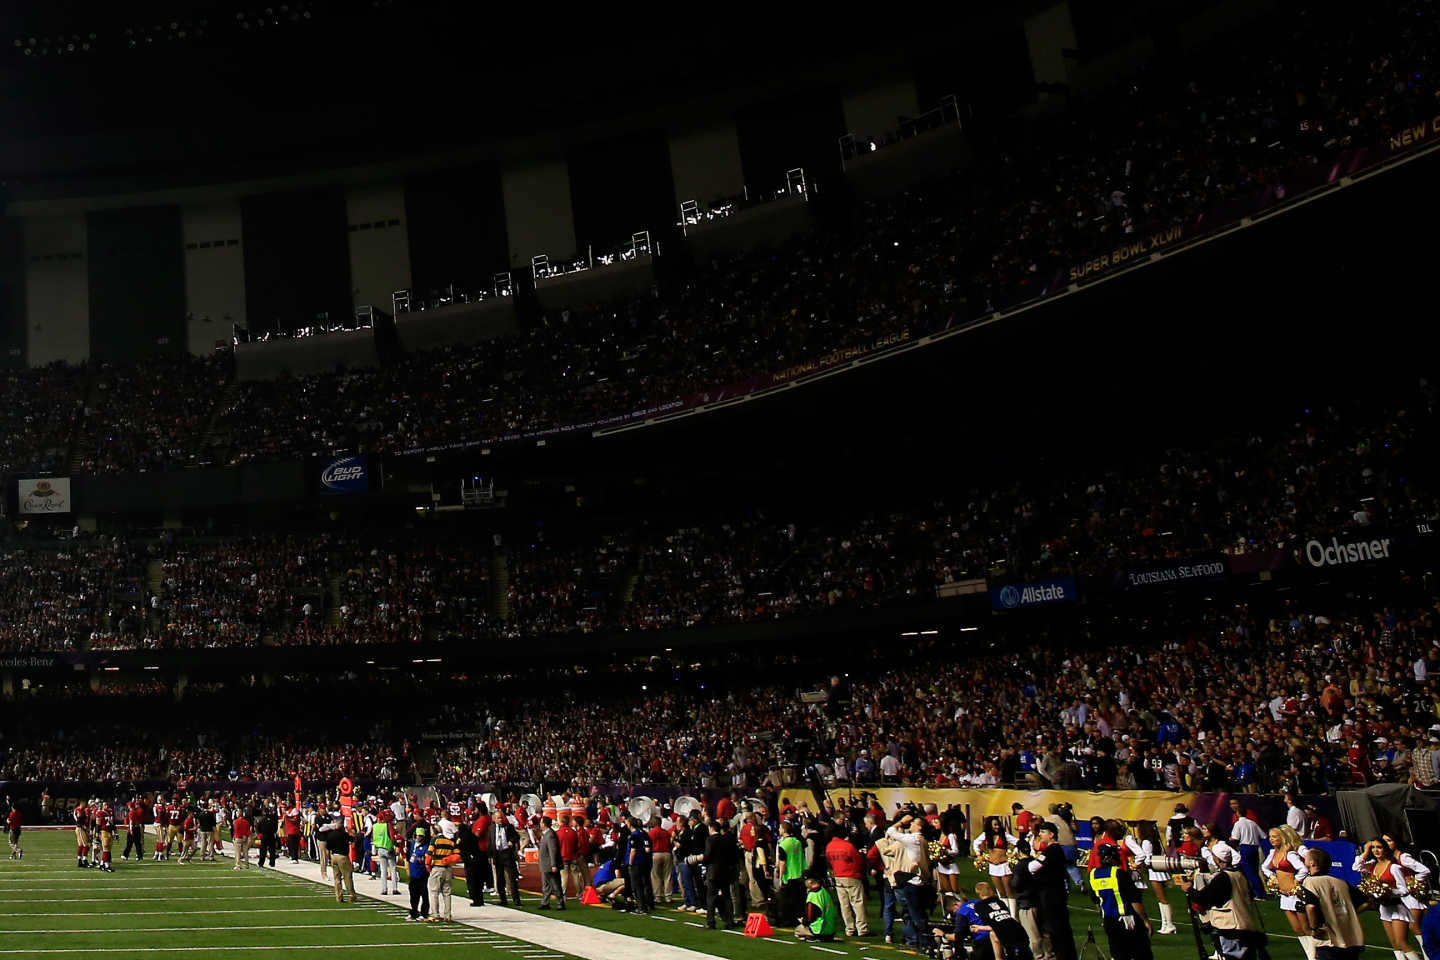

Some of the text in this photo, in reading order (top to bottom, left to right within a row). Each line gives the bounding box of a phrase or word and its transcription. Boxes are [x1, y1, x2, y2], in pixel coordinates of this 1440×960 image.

[1387, 120, 1425, 151] NEW
[1070, 256, 1110, 281] SUPER
[1111, 240, 1148, 264] BOWL
[327, 471, 364, 482] LIGHT
[333, 466, 362, 476] BUD
[1305, 536, 1391, 569] Ochsner
[1128, 560, 1225, 587] LOUISIANA SEAFOOD
[1019, 582, 1065, 604] Allstate
[1151, 758, 1163, 769] 93
[169, 810, 180, 820] 77
[449, 805, 461, 816] 52
[745, 915, 761, 938] 20
